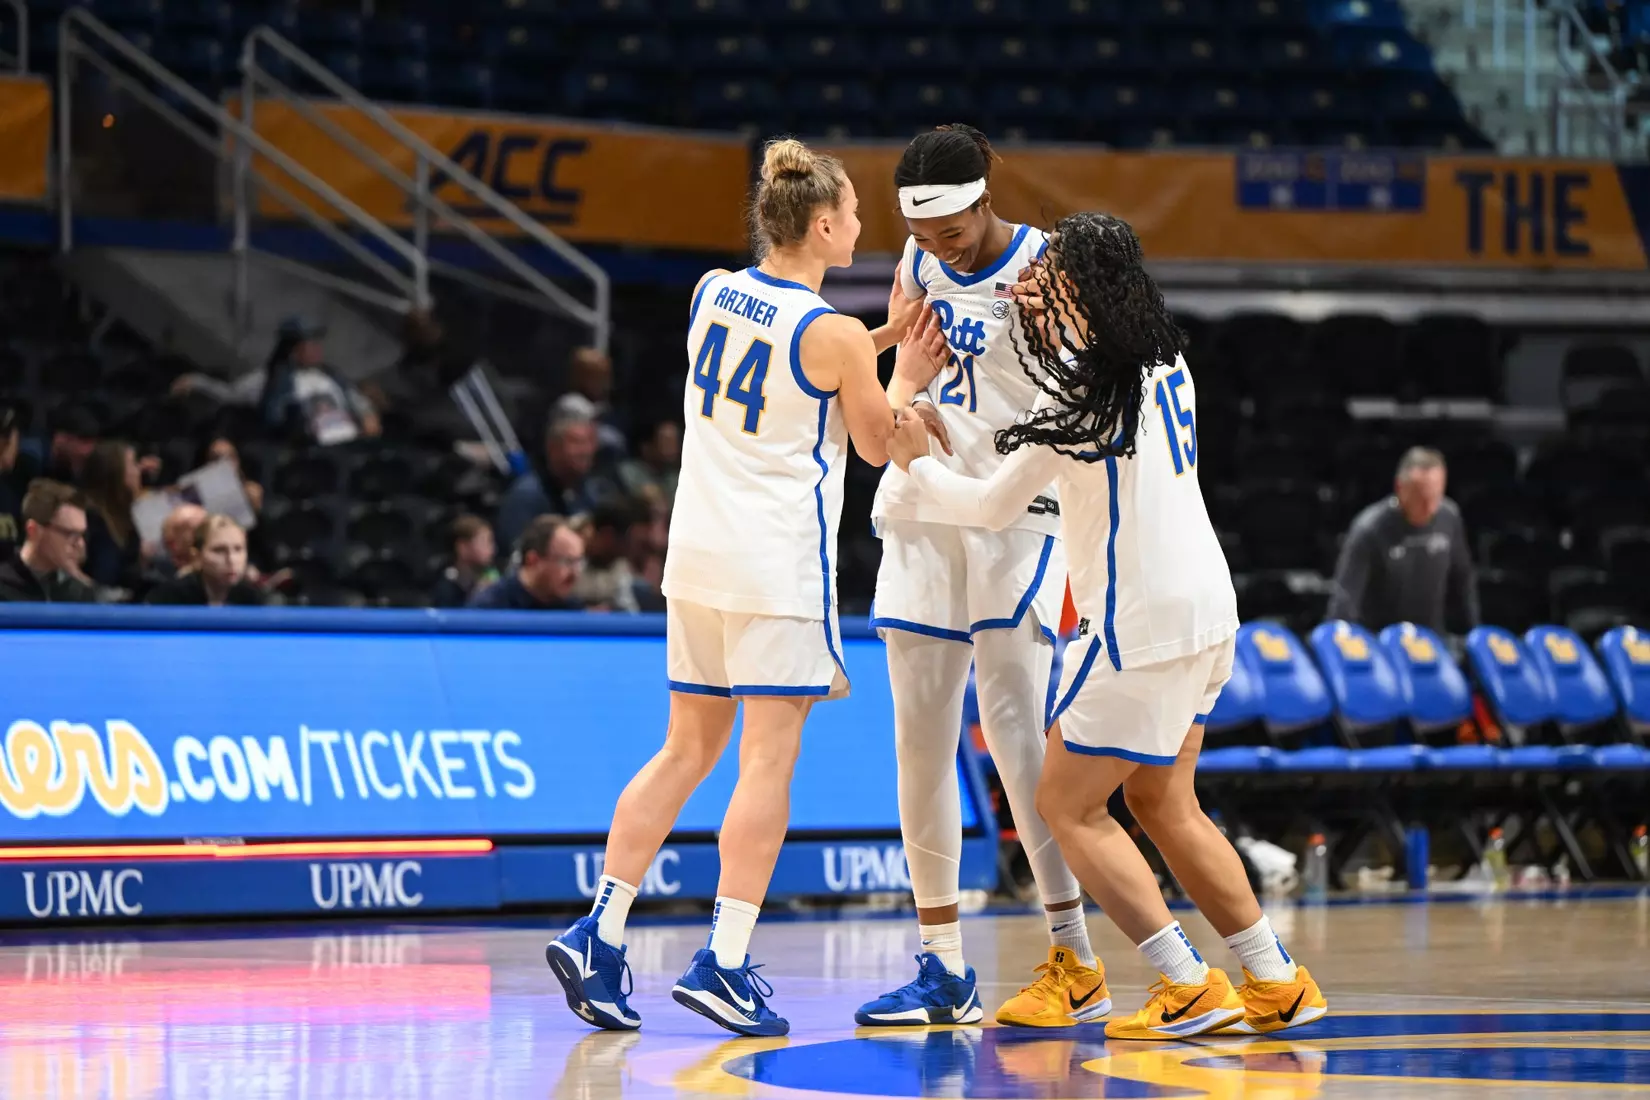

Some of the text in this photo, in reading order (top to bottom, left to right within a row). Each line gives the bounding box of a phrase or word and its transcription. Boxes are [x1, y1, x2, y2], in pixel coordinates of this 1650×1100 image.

[430, 131, 590, 204] ACC
[1455, 168, 1592, 257] THE
[714, 286, 778, 328] ARZNER
[931, 299, 986, 356] Pitt
[693, 319, 774, 437] 44
[939, 352, 977, 414] 21
[1153, 366, 1197, 478] 15
[0, 718, 535, 820] ers.COM/TICKETS
[24, 868, 143, 918] UPMC
[310, 861, 423, 910] UPMC
[573, 849, 681, 897] UC
